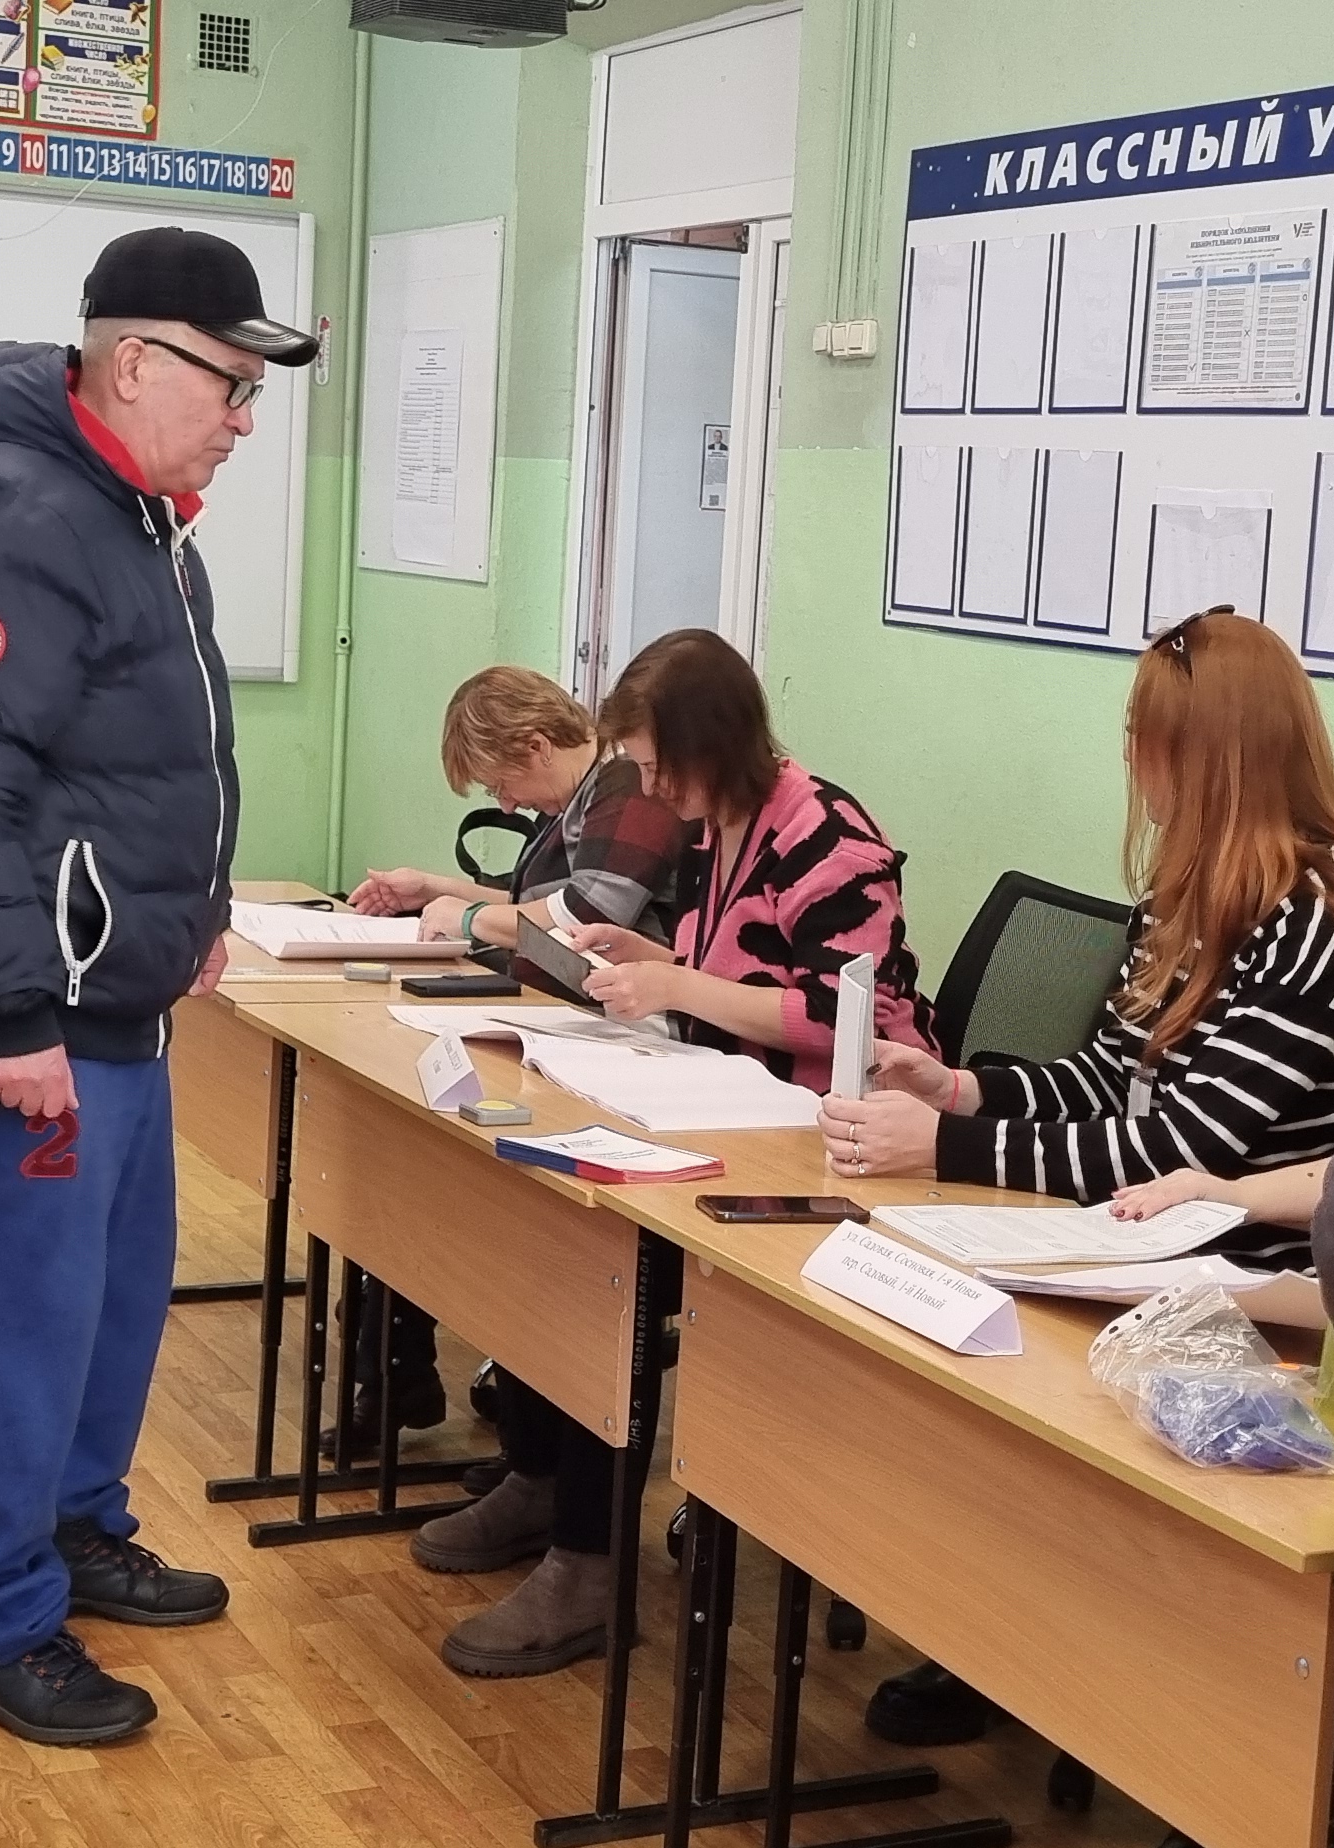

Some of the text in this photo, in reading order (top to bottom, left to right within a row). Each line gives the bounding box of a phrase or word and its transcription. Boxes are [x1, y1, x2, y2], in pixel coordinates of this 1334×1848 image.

[1, 138, 15, 166] 9
[22, 140, 44, 169] 10
[49, 143, 68, 172] 11
[74, 145, 96, 174] 12
[100, 148, 120, 177] 13
[126, 150, 147, 180] 14
[151, 153, 171, 181] 15
[175, 155, 197, 184] 16
[200, 158, 221, 186] 17
[223, 160, 245, 188] 18
[248, 163, 269, 190] 19
[270, 164, 293, 193] 20
[983, 97, 1285, 197] КЛАССНЫЙ
[19, 1109, 81, 1178] 2
[950, 1278, 983, 1302] Новая
